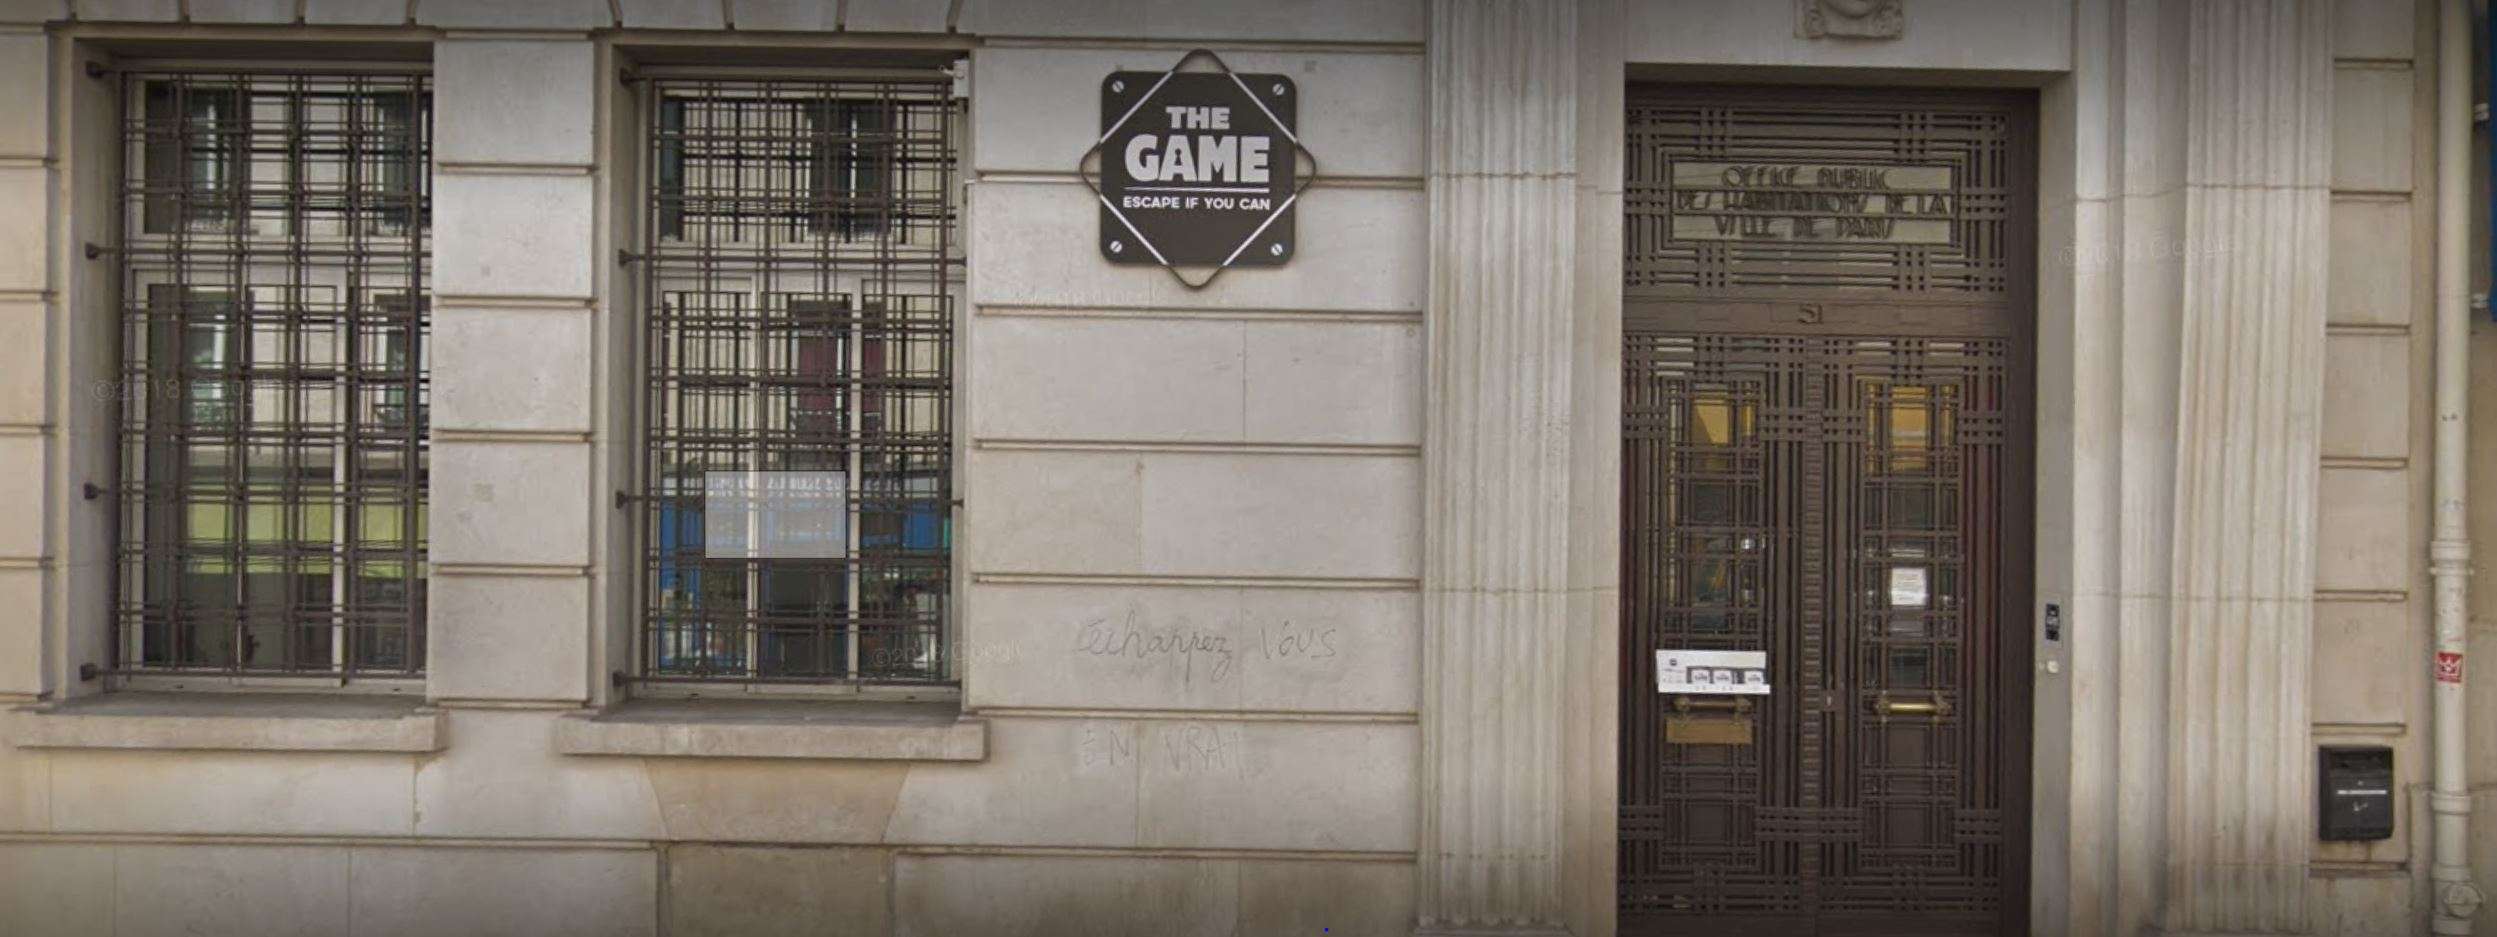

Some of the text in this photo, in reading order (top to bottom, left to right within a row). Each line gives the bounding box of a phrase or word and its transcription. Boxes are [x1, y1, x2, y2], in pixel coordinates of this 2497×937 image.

[1166, 106, 1230, 129] THE
[1124, 134, 1270, 183] GAME
[1123, 196, 1270, 212] ESCAPE IF YOU CAN
[1916, 194, 1948, 215] LA
[1714, 215, 1777, 236] VILLE
[1799, 303, 1823, 325] 51
